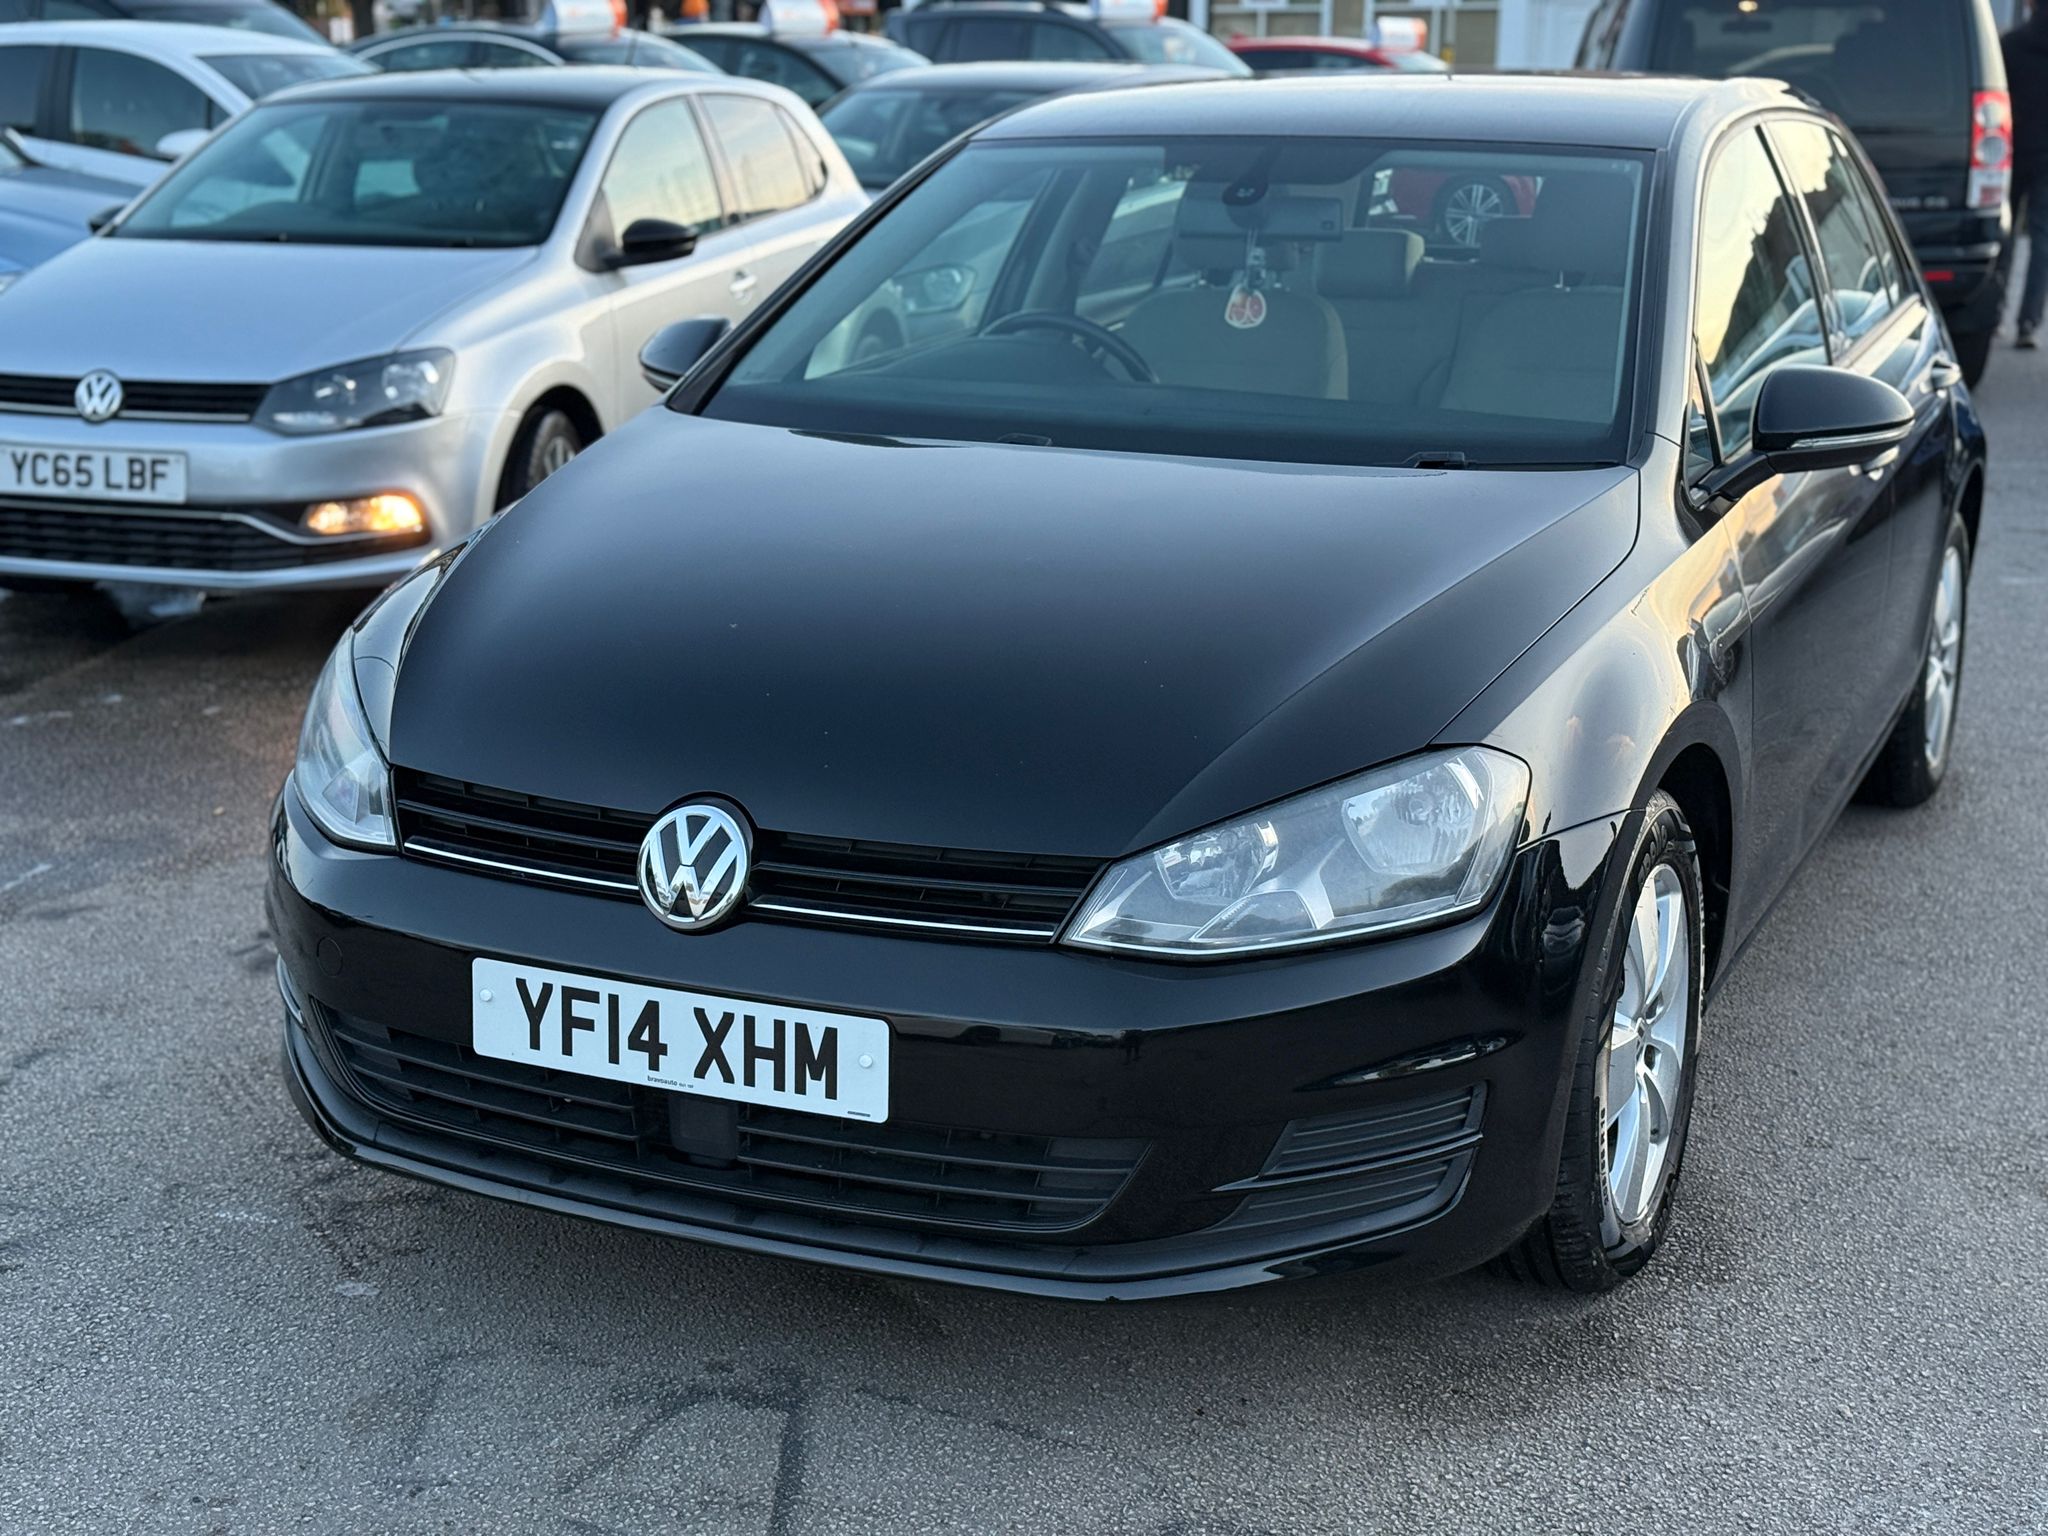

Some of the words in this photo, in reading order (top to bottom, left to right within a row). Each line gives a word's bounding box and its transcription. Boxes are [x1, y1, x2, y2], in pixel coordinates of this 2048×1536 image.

[11, 451, 94, 488] YC65
[104, 456, 170, 492] LBF
[640, 806, 746, 926] VW
[515, 977, 668, 1072] YF14
[693, 1006, 838, 1101] XHM
